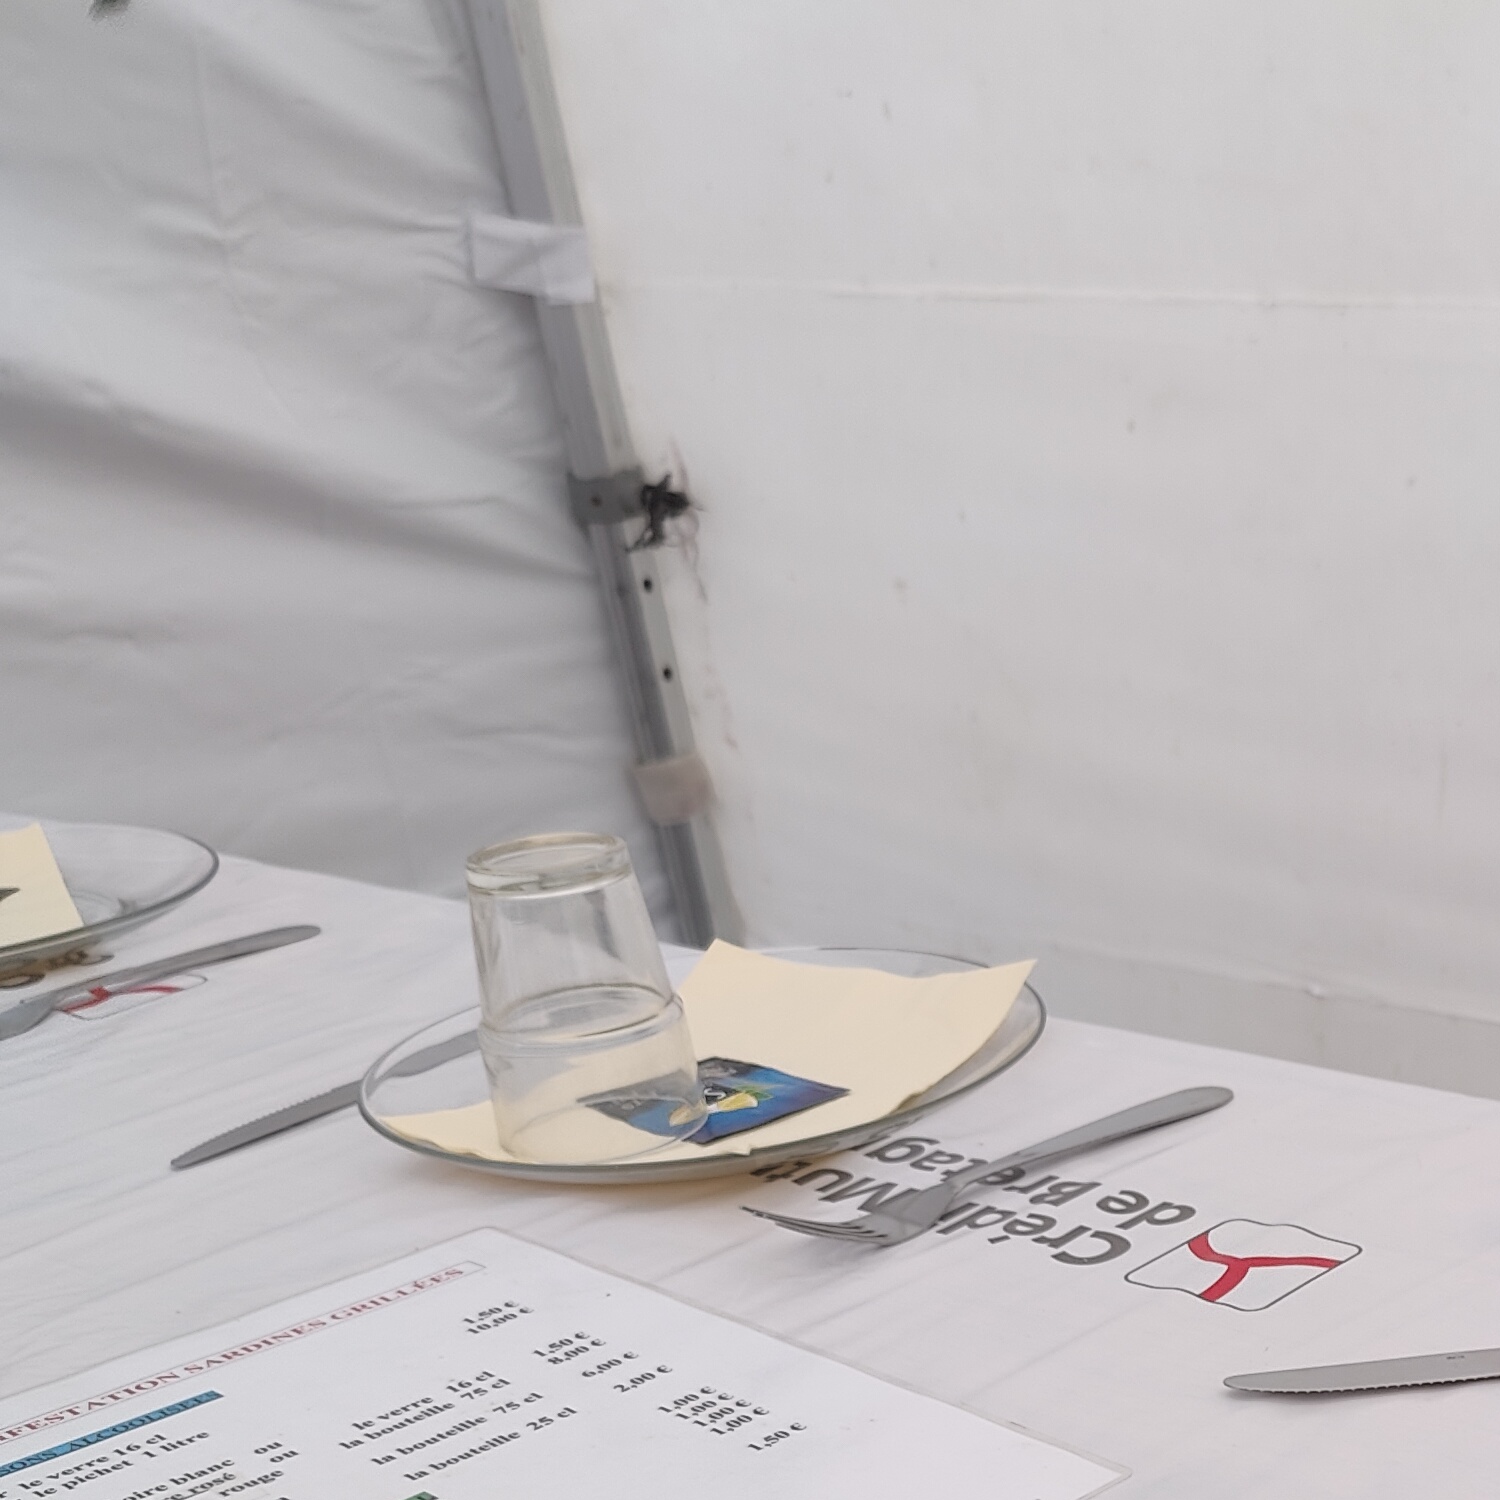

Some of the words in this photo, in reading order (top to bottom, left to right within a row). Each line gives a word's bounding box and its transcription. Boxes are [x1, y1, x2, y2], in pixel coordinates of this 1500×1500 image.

[1095, 1190, 1197, 1231] de
[928, 1201, 1132, 1266] Crédi
[183, 1318, 327, 1374] SARDINES
[330, 1267, 464, 1321] GRILLÉES
[462, 1305, 503, 1325] 1,50
[504, 1299, 520, 1309] €
[466, 1312, 517, 1335] 10,00
[518, 1306, 534, 1316] €
[532, 1337, 574, 1358] 1,50
[574, 1331, 590, 1341] €
[547, 1345, 590, 1365] 8,00
[591, 1338, 607, 1348] €
[582, 1358, 622, 1378] 6,00
[623, 1351, 640, 1361] €
[613, 1371, 656, 1393] 2,00
[656, 1365, 673, 1374] €
[339, 1438, 364, 1450] la
[364, 1401, 456, 1440] bouteille
[460, 1387, 489, 1401] 75
[491, 1378, 511, 1390] cl
[352, 1418, 375, 1431] le
[377, 1396, 434, 1422] verre
[446, 1380, 473, 1394] 16
[475, 1370, 496, 1383] cl
[657, 1393, 700, 1414] 1,00
[700, 1386, 717, 1396] €
[675, 1399, 718, 1421] 1,00
[718, 1392, 735, 1402] €
[692, 1406, 735, 1428] 1,00
[735, 1399, 752, 1409] €
[371, 1454, 397, 1466] la
[396, 1415, 488, 1456] bouteille
[492, 1401, 521, 1415] 75
[523, 1391, 544, 1405] cl
[710, 1414, 753, 1437] 1,00
[753, 1406, 770, 1417] €
[747, 1429, 791, 1452] 1,50
[790, 1421, 807, 1432] €
[404, 1469, 430, 1482] la
[429, 1430, 522, 1471] bouteille
[526, 1416, 555, 1431] 25
[556, 1406, 578, 1420] cl
[18, 1479, 43, 1490] le
[46, 1455, 109, 1480] verre
[114, 1443, 142, 1457] 16
[145, 1433, 167, 1446] cl
[32, 1487, 58, 1498] le
[61, 1459, 134, 1490] pichet
[143, 1450, 158, 1459] 1
[160, 1431, 211, 1453] litre
[169, 1459, 236, 1487] blanc
[254, 1441, 283, 1456] ou
[188, 1472, 237, 1497] rosé
[269, 1449, 300, 1464] ou
[218, 1468, 285, 1498] rouge
